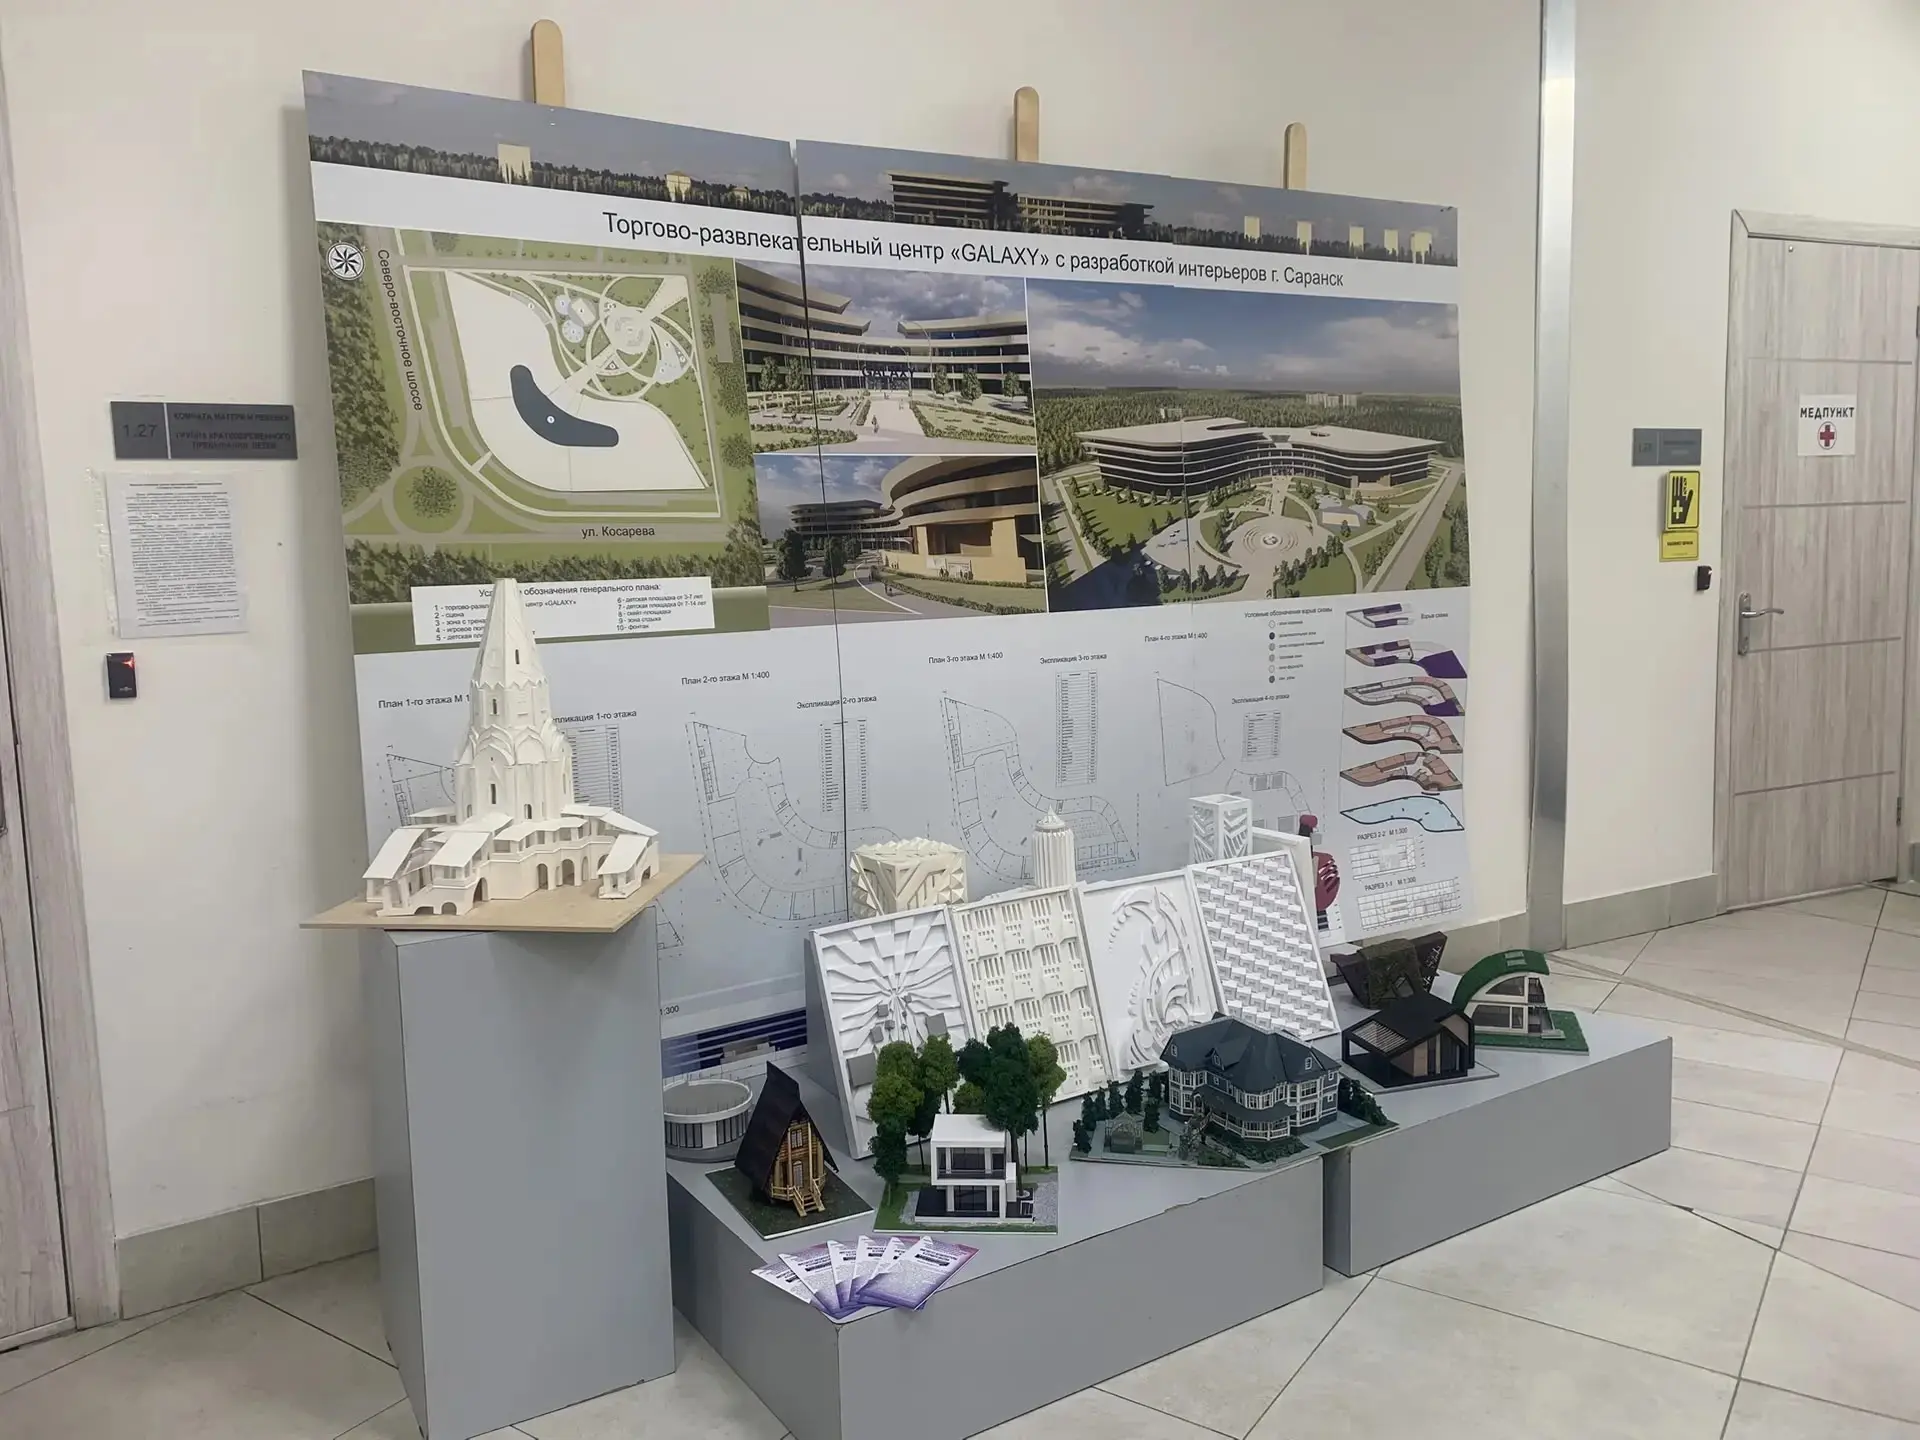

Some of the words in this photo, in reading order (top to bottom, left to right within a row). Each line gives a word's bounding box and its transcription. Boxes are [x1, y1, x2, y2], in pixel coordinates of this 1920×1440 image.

[603, 212, 882, 256] Торгово-развлекательный
[889, 241, 944, 262] центр
[951, 243, 1048, 266] «GALAXY»
[1055, 255, 1065, 268] с
[1070, 252, 1174, 275] разработкой
[1179, 263, 1267, 284] интерьеров
[1271, 270, 1280, 283] г.
[1284, 267, 1343, 287] Саранск
[377, 250, 412, 367] Северо-восточное
[406, 371, 422, 411] шоссе
[862, 366, 916, 379] GALAXY
[1800, 407, 1855, 420] МЕДПУНКТ
[123, 424, 158, 438] 1.27
[581, 528, 598, 539] ул.
[601, 526, 655, 538] Косарева
[524, 586, 578, 596] обозначения
[580, 584, 634, 595] генерального
[635, 584, 661, 592] плана:
[928, 656, 945, 664] План
[1040, 656, 1077, 664] Экспликация
[681, 677, 701, 685] План
[719, 674, 740, 682] этажа
[742, 672, 749, 680] М
[751, 671, 770, 680] 1:400
[378, 700, 403, 708] План
[425, 696, 452, 704] этажа
[454, 694, 462, 702] М
[797, 699, 840, 709] Экспликация
[553, 714, 594, 723] пликация
[660, 1005, 679, 1016] 1:300
